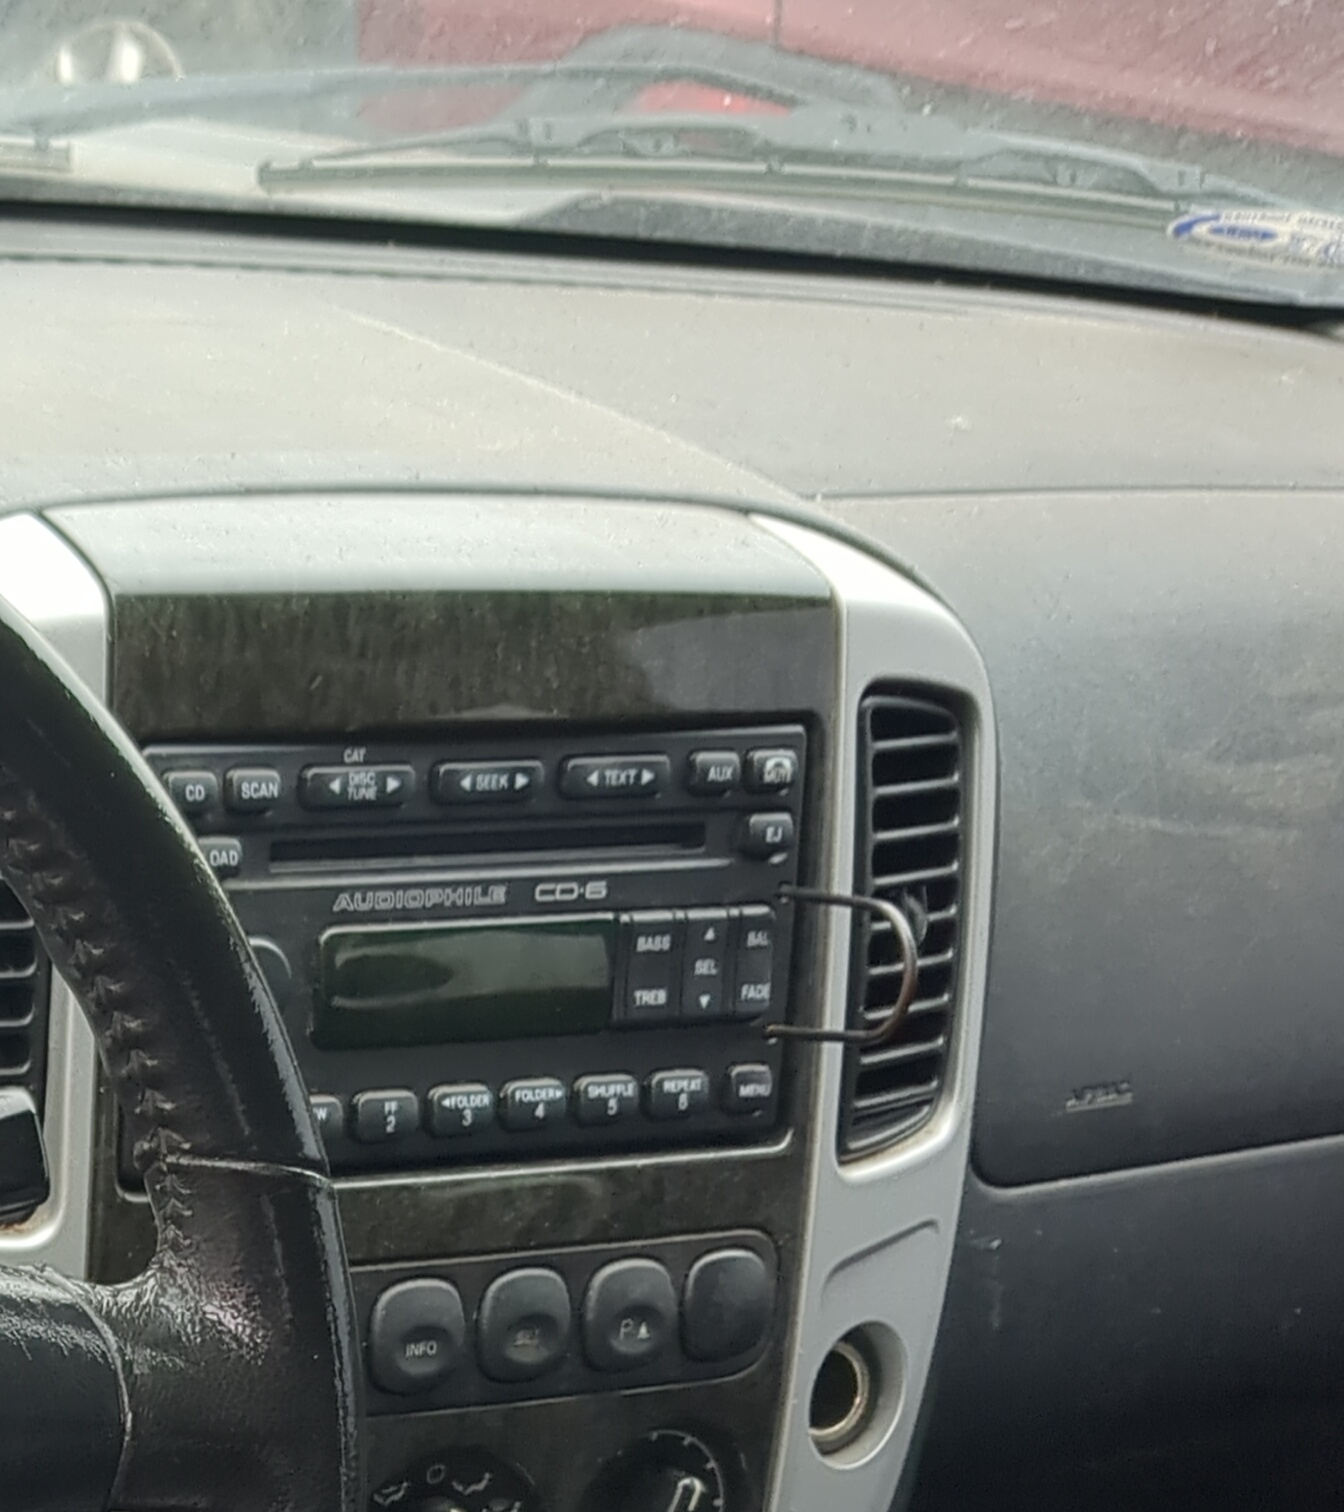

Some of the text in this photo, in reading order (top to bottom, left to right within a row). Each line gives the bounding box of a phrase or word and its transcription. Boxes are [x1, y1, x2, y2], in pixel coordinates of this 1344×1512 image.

[343, 747, 366, 764] CAT
[348, 771, 376, 786] DISC
[476, 772, 508, 791] SEEK
[604, 770, 637, 786] TEXT
[707, 765, 733, 783] AUX
[185, 784, 205, 801] CD
[241, 781, 279, 799] SCAN
[347, 785, 378, 801] TUNE
[766, 826, 783, 843] EJ
[209, 850, 238, 867] OAD
[332, 885, 508, 912] AUDIOPHILE
[636, 935, 672, 953] BASS
[694, 958, 717, 976] SEL
[634, 988, 667, 1007] TREB
[588, 1083, 634, 1098] SHUFFLE
[663, 1078, 702, 1092] REPEAT
[739, 1083, 771, 1098] MENU
[451, 1094, 490, 1109] FOLDER
[515, 1087, 555, 1102] FOLDER
[534, 1102, 545, 1119] 4
[607, 1099, 617, 1116] 5
[386, 1116, 396, 1133] 2
[462, 1110, 472, 1127] 3
[405, 1340, 437, 1357] INFO
